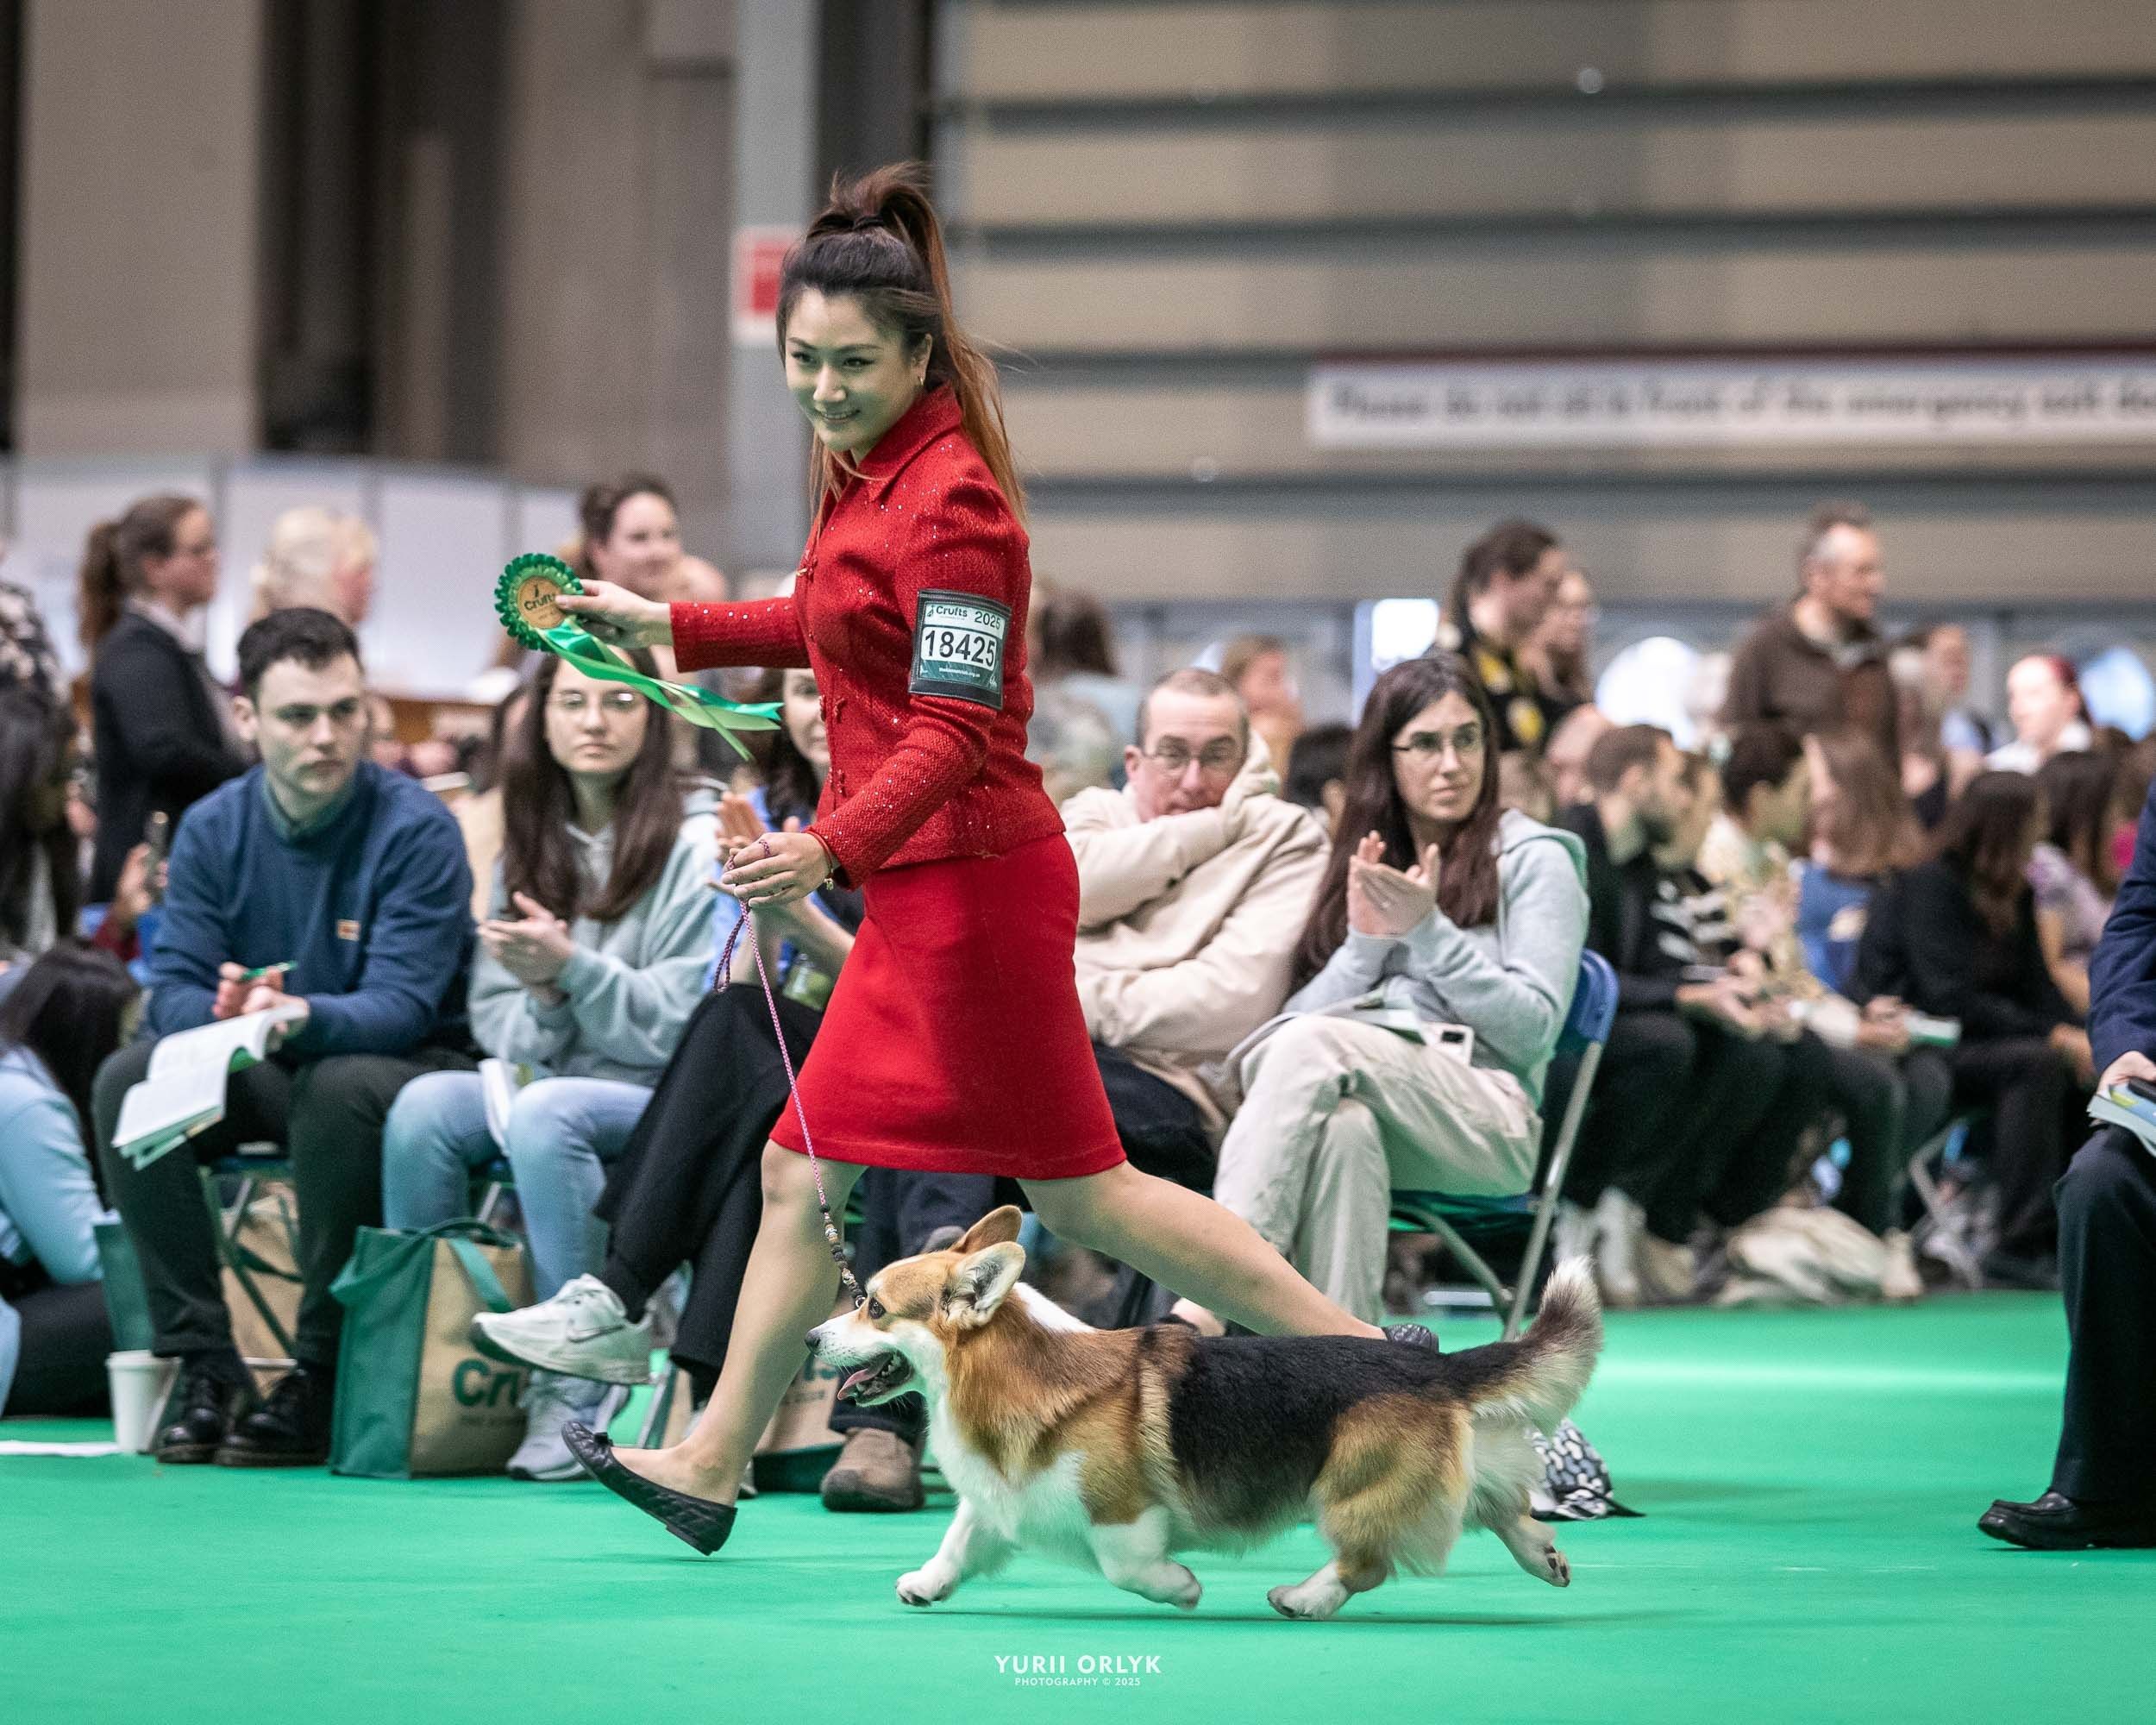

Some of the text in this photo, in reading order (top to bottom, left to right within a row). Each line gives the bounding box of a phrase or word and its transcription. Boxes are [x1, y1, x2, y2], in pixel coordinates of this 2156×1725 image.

[936, 605, 1000, 630] Crufts 2025
[925, 630, 995, 668] 18425
